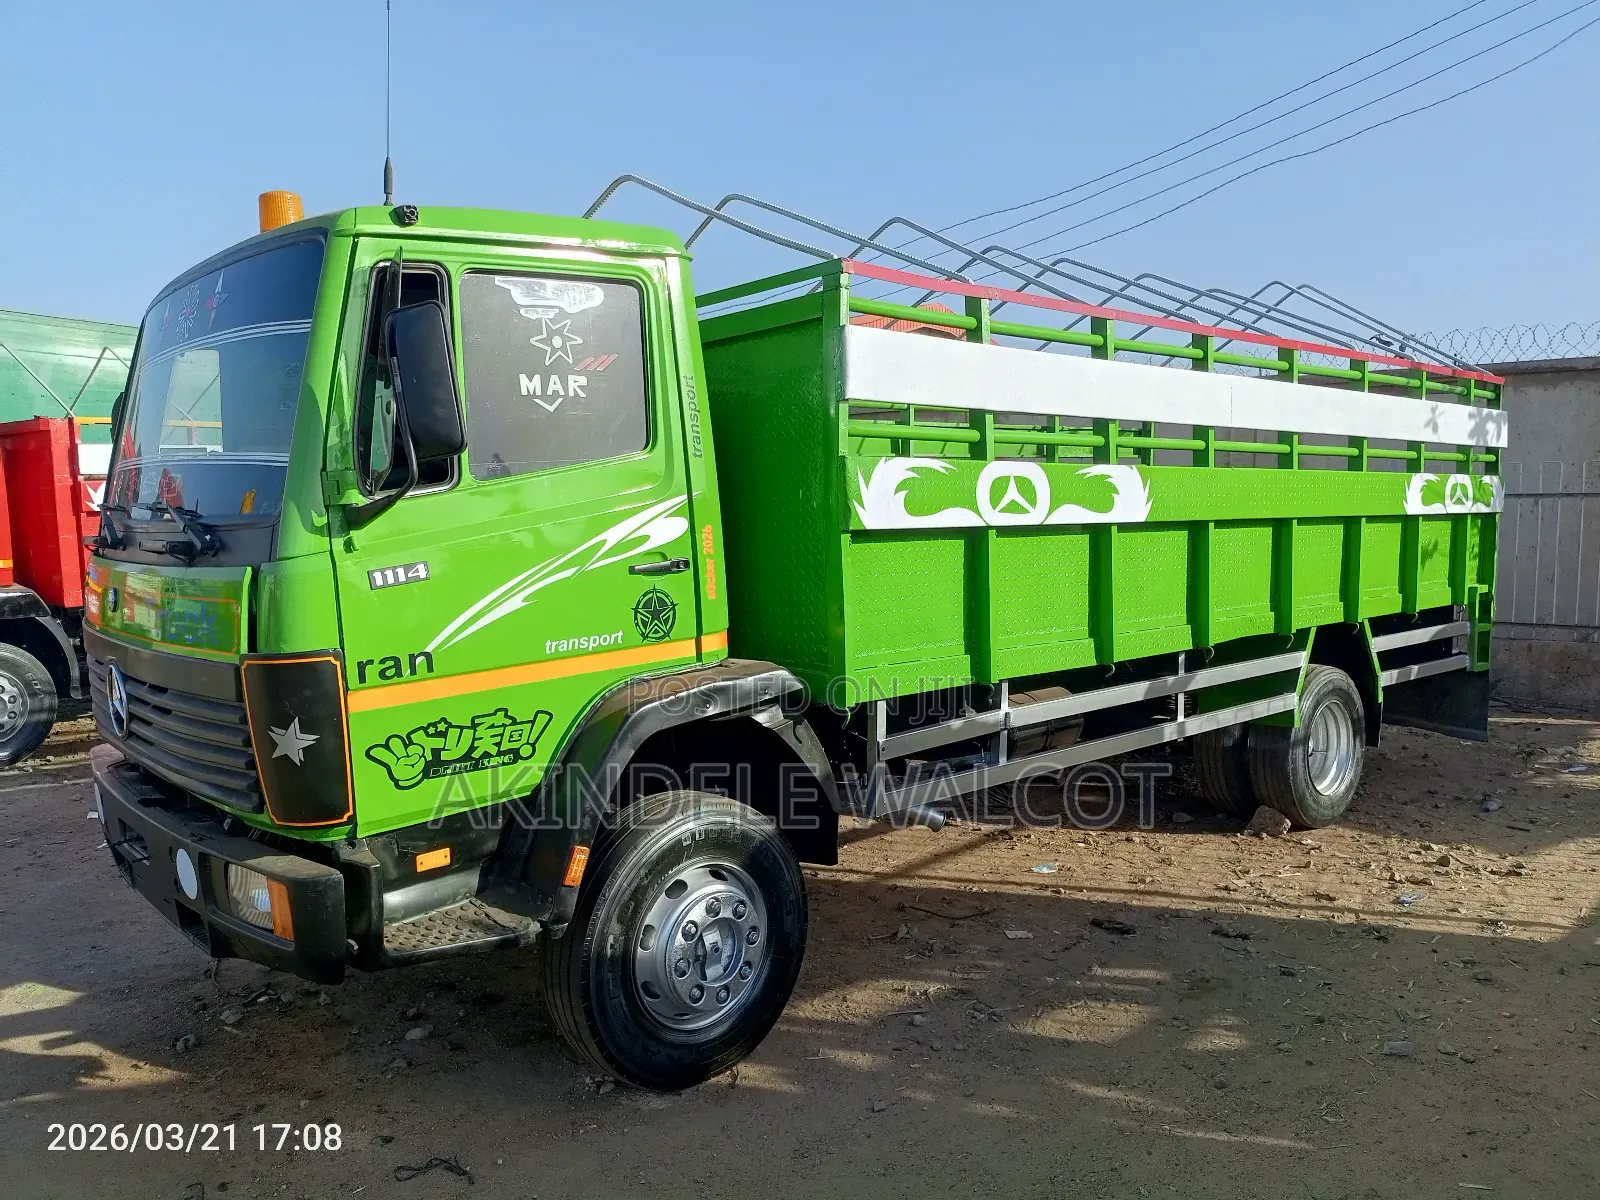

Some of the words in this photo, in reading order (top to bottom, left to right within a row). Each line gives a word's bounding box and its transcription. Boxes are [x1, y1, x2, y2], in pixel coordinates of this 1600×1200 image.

[518, 373, 588, 398] MAR
[683, 375, 703, 459] transport
[702, 524, 714, 555] 2026
[371, 562, 429, 587] 1114
[544, 630, 624, 654] transport
[356, 651, 435, 685] ran
